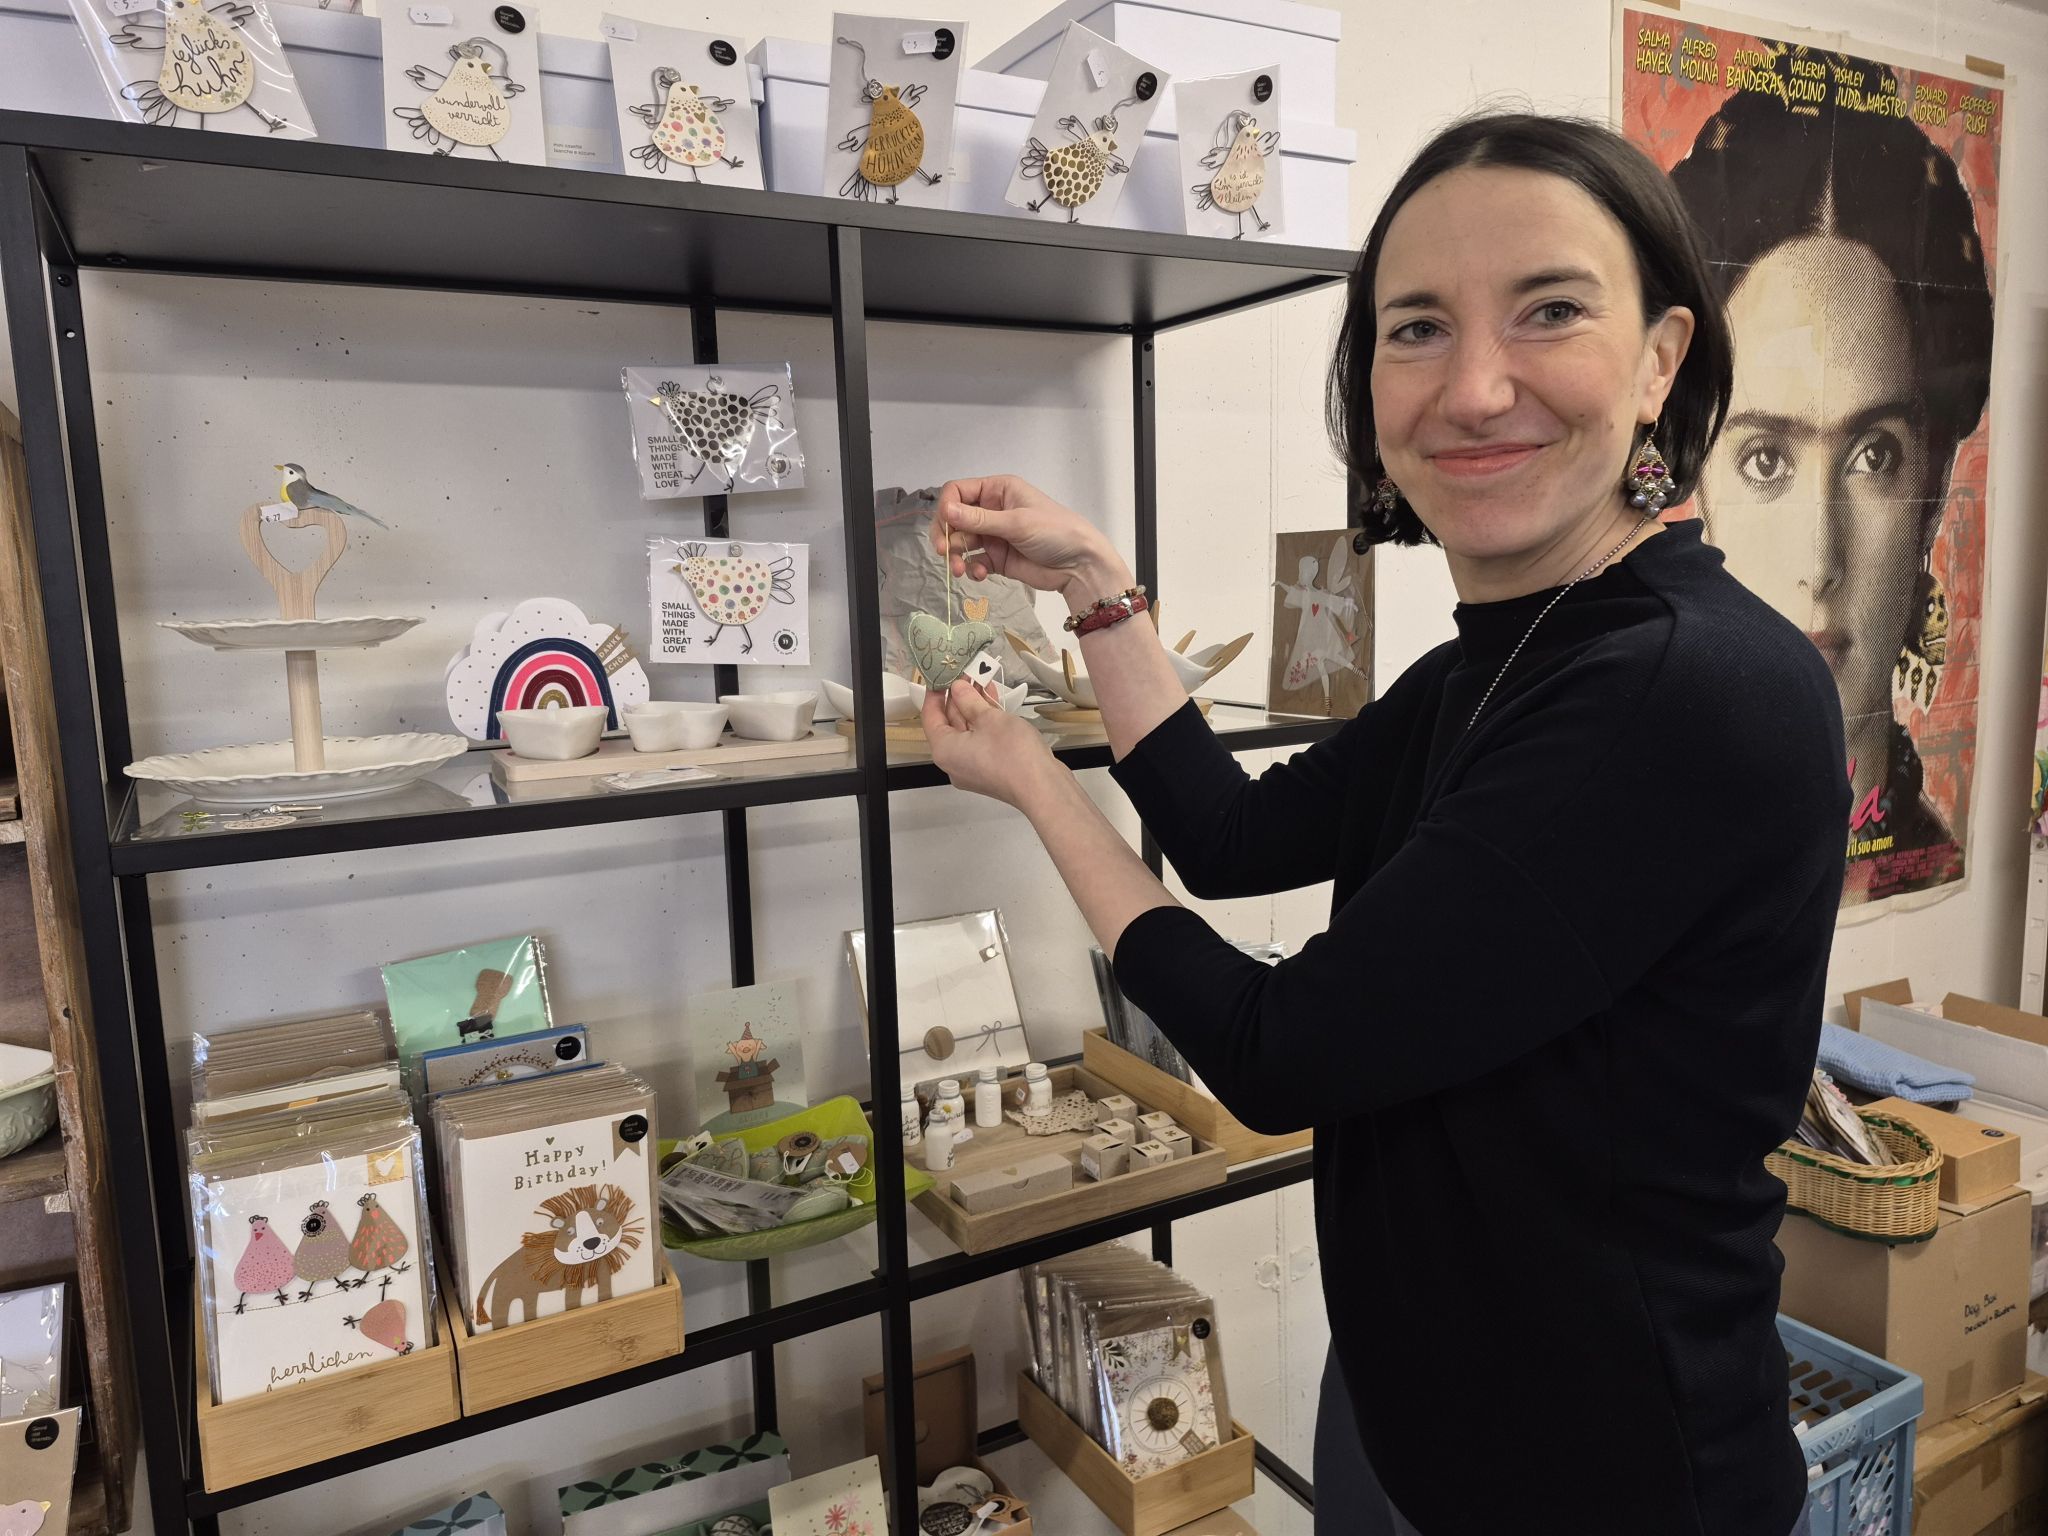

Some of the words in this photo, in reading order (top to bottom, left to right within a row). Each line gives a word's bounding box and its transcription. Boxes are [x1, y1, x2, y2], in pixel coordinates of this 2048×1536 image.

[1638, 28, 1670, 49] SALMA
[1682, 37, 1717, 60] ALFRED
[1636, 49, 1672, 75] HAYEK
[1734, 48, 1776, 69] ANTONIO
[1790, 58, 1826, 80] VALERIA
[168, 51, 245, 97] huhn
[1680, 58, 1719, 84] MOLINA
[1726, 66, 1782, 95] BANDERAS
[1835, 67, 1864, 87] ASHLEY
[1788, 78, 1826, 102] GOLINO
[1881, 75, 1895, 93] MIA
[435, 92, 506, 111] wundervoll
[1836, 87, 1861, 110] JUDD
[1867, 91, 1907, 119] MAESTRO
[1916, 84, 1948, 106] EDWARD
[1913, 104, 1948, 128] NORTON
[1960, 95, 1996, 117] GEOFFREY
[448, 111, 501, 127] verrückt
[1965, 113, 1988, 135] RUSH
[648, 436, 678, 444] SMALL
[649, 443, 683, 453] THINGS
[651, 453, 677, 461] MADE
[652, 462, 675, 470] WITH
[654, 471, 683, 479] GREAT
[655, 480, 679, 488] LOVE
[662, 602, 692, 610] SMALL
[662, 611, 696, 619] THINGS
[662, 628, 685, 636] WITH
[662, 637, 692, 645] GREAT
[599, 633, 622, 658] DANKE
[663, 645, 686, 653] LOVE
[1851, 837, 1858, 857] il
[1857, 840, 1871, 855] suo
[525, 1145, 584, 1167] Happy
[514, 1159, 607, 1190] Birthday!
